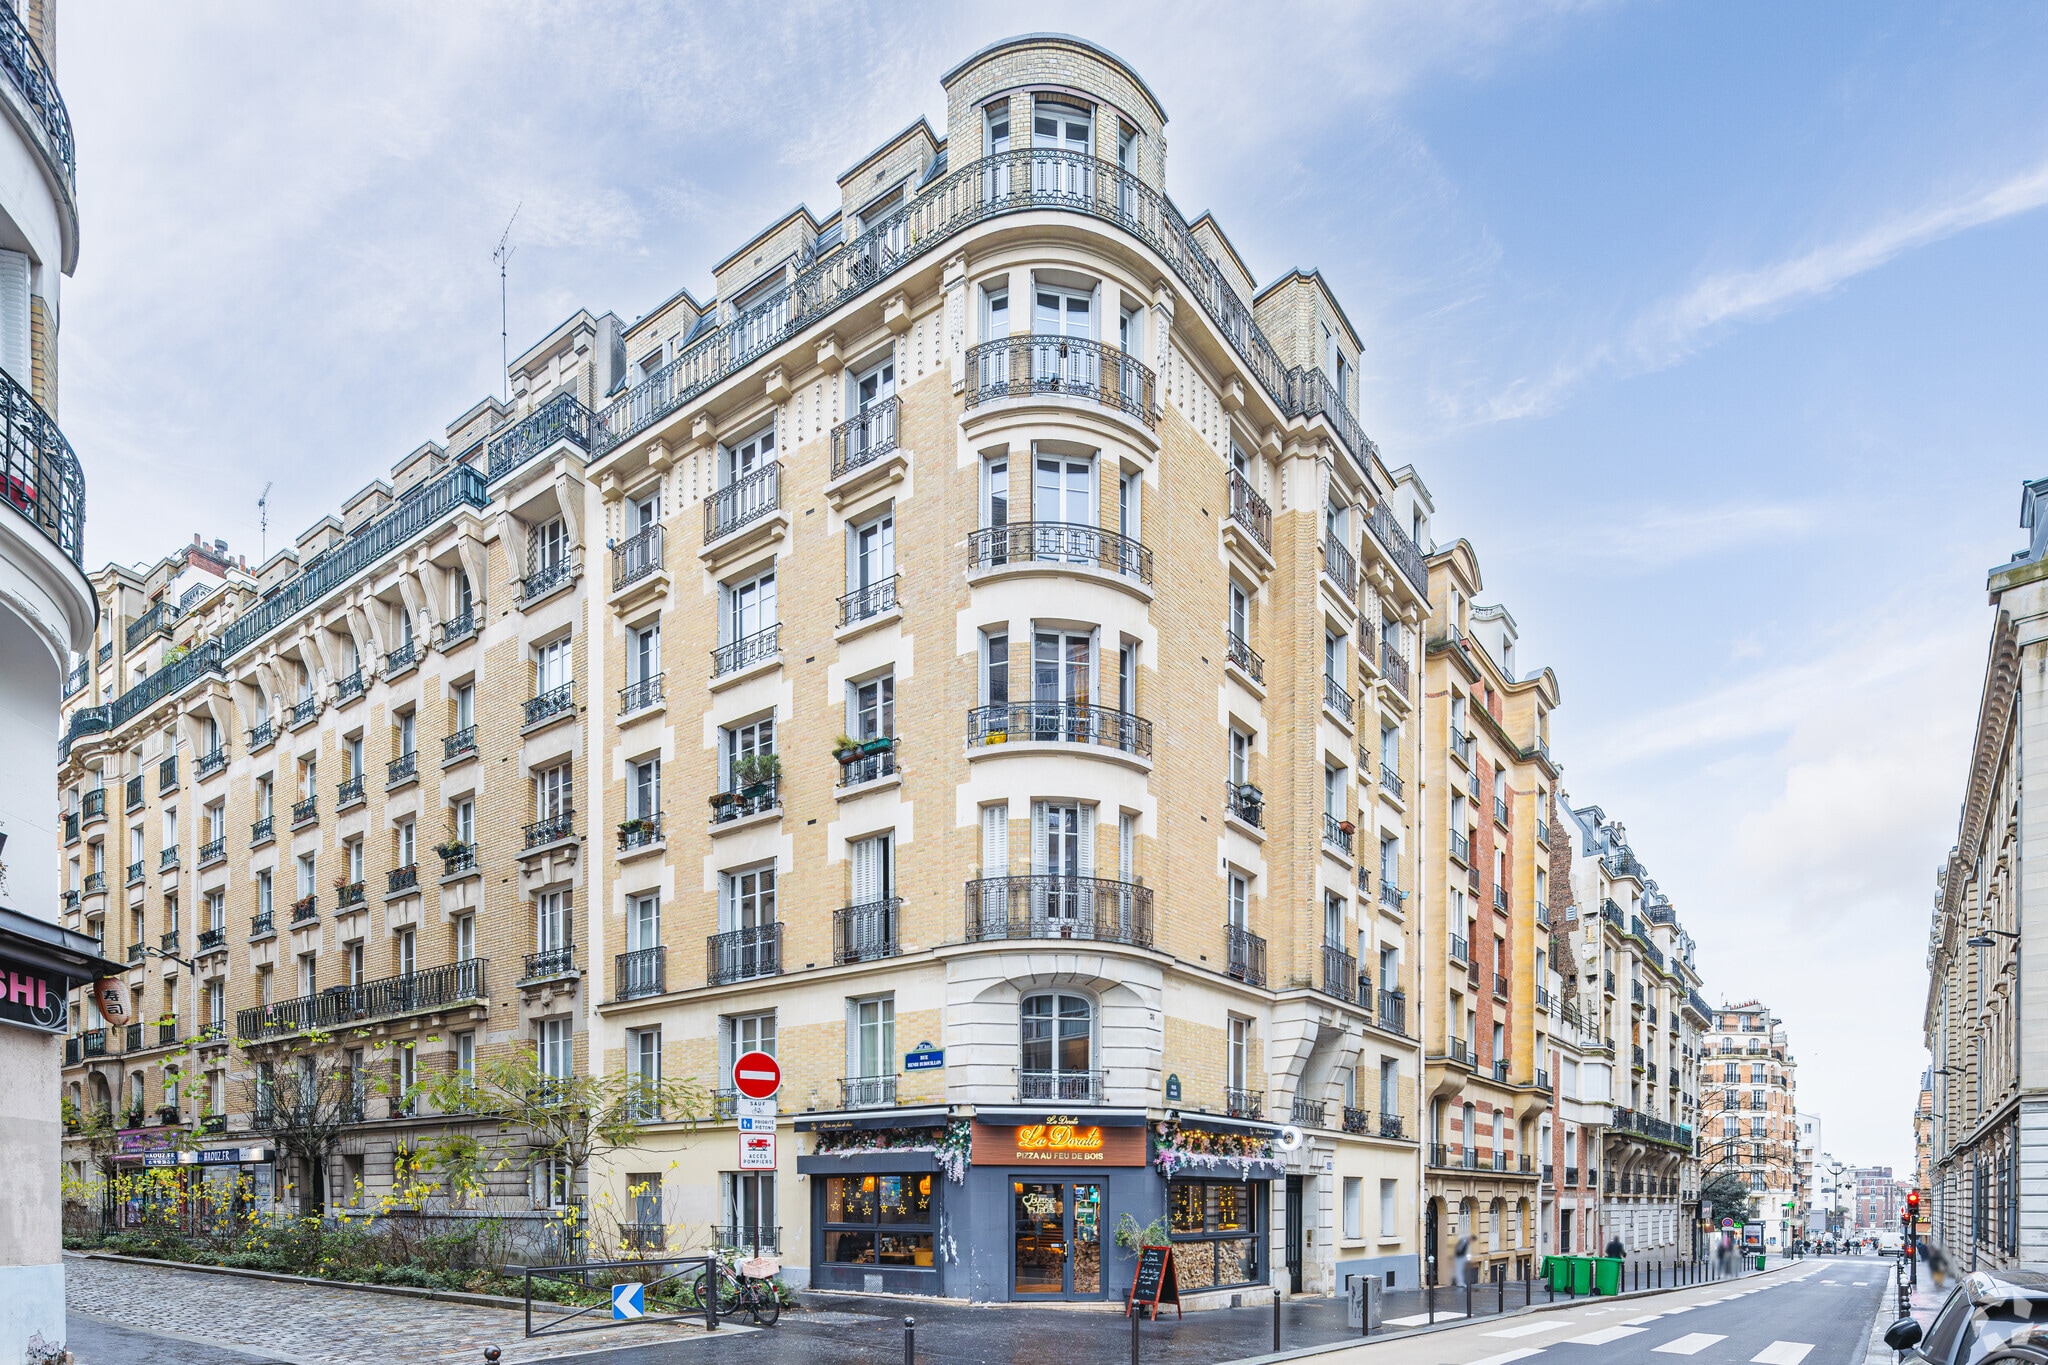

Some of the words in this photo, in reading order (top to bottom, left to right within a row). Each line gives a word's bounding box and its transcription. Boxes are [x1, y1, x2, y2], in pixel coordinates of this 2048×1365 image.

[103, 989, 123, 1015] 寿司
[1046, 1114, 1058, 1125] La
[1058, 1114, 1079, 1125] Dorata
[1018, 1125, 1047, 1147] La
[1048, 1125, 1101, 1148] Dorata
[1016, 1152, 1039, 1160] PIZZA
[1040, 1152, 1052, 1160] AU
[1054, 1152, 1070, 1160] FEU
[1072, 1152, 1083, 1160] DE
[1084, 1152, 1104, 1160] BOIS
